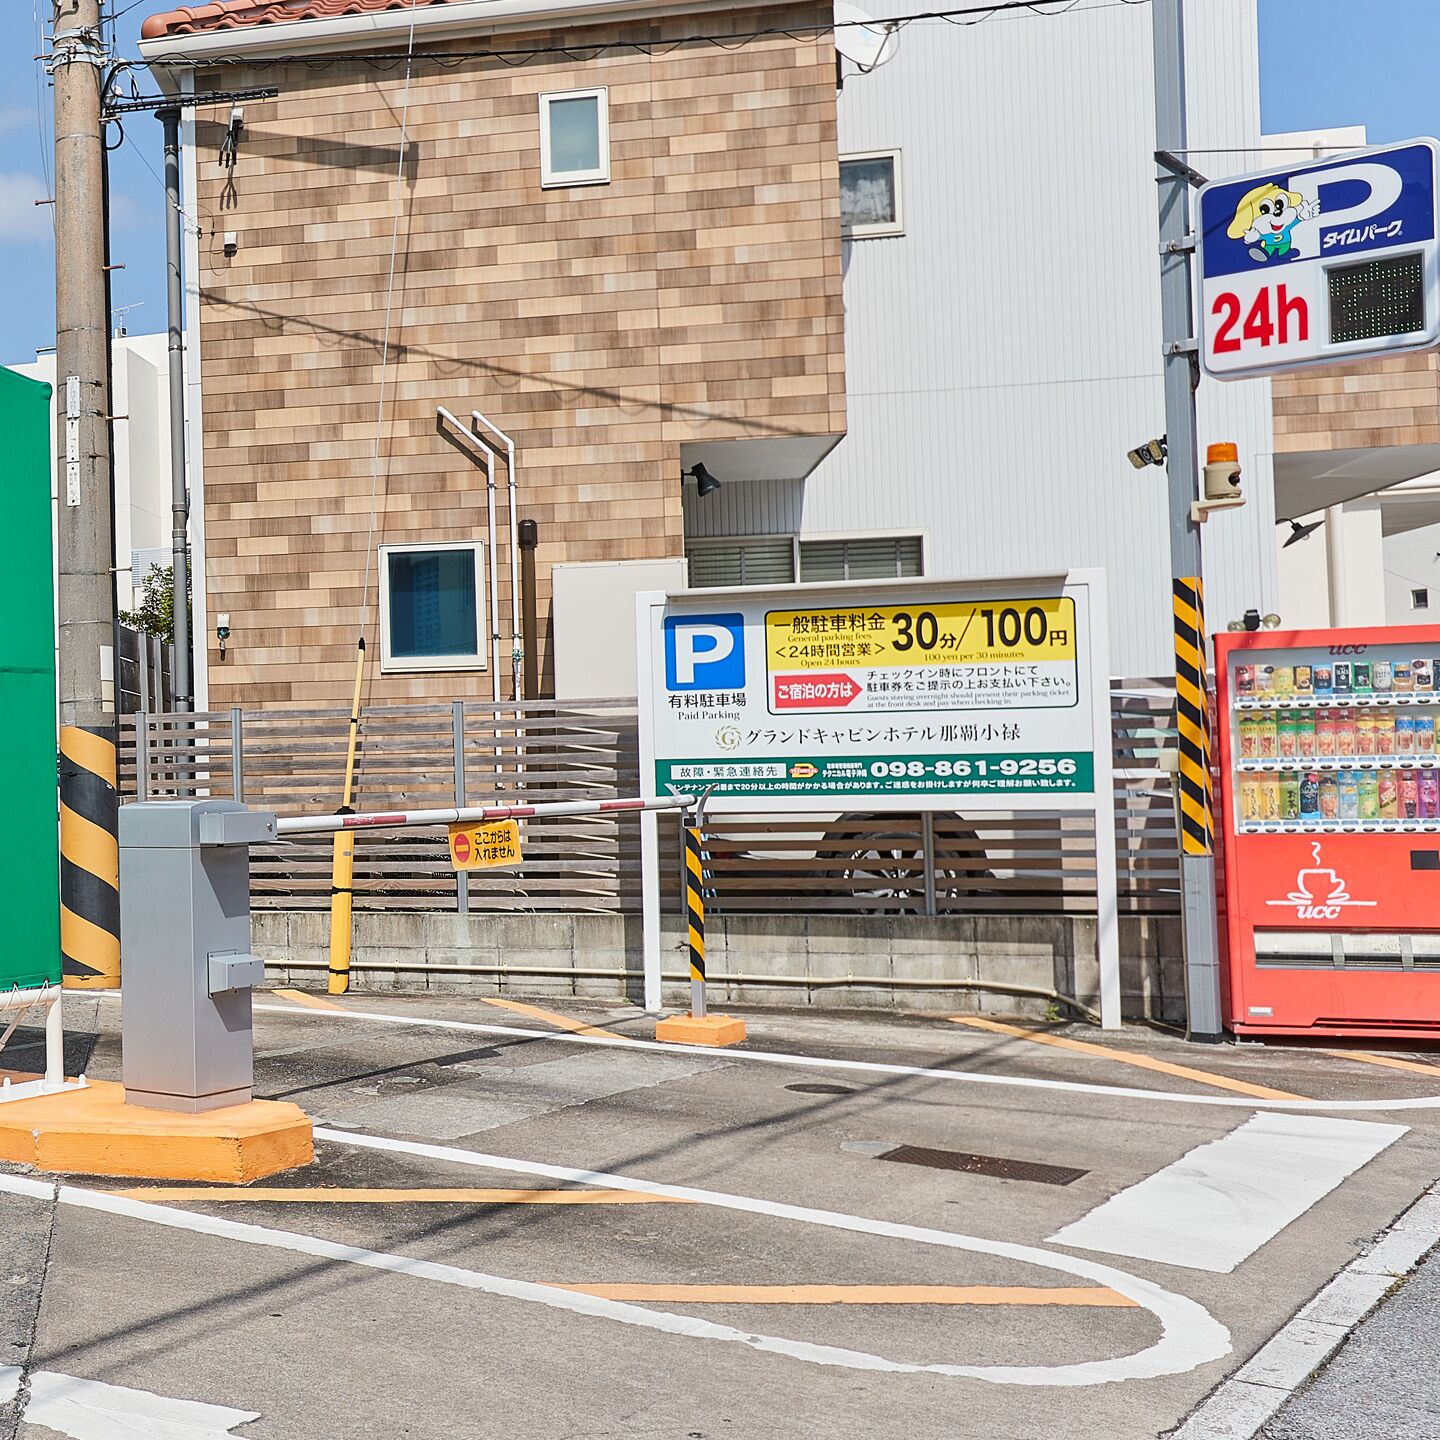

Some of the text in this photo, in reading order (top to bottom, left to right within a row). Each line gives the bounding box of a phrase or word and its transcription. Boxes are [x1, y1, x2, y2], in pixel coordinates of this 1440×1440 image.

[1288, 163, 1403, 261] P
[1323, 219, 1403, 249] タイムパーク
[1212, 284, 1308, 354] 24h
[774, 612, 885, 634] 一般駐車料金
[788, 632, 872, 643] General parking fees
[675, 623, 734, 683] P
[924, 651, 1025, 662] 100 yen per 30 minutes
[801, 659, 822, 668] Open
[837, 658, 860, 666] hours
[867, 665, 1038, 681] チェックイン時にフロントにて
[778, 682, 853, 700] ご宿泊の方は
[867, 677, 1070, 692] 駐車券をご提示の上お支払い下さい。
[668, 693, 746, 709] 有料駐車場
[678, 710, 740, 721] Paid Parking
[747, 723, 1020, 746] グランドキャビンホテル那覇小禄
[680, 765, 778, 778] 故障・緊急連絡先
[871, 758, 1077, 777] 098-861-9256
[475, 829, 511, 845] ここからは
[474, 845, 515, 861] 入れません
